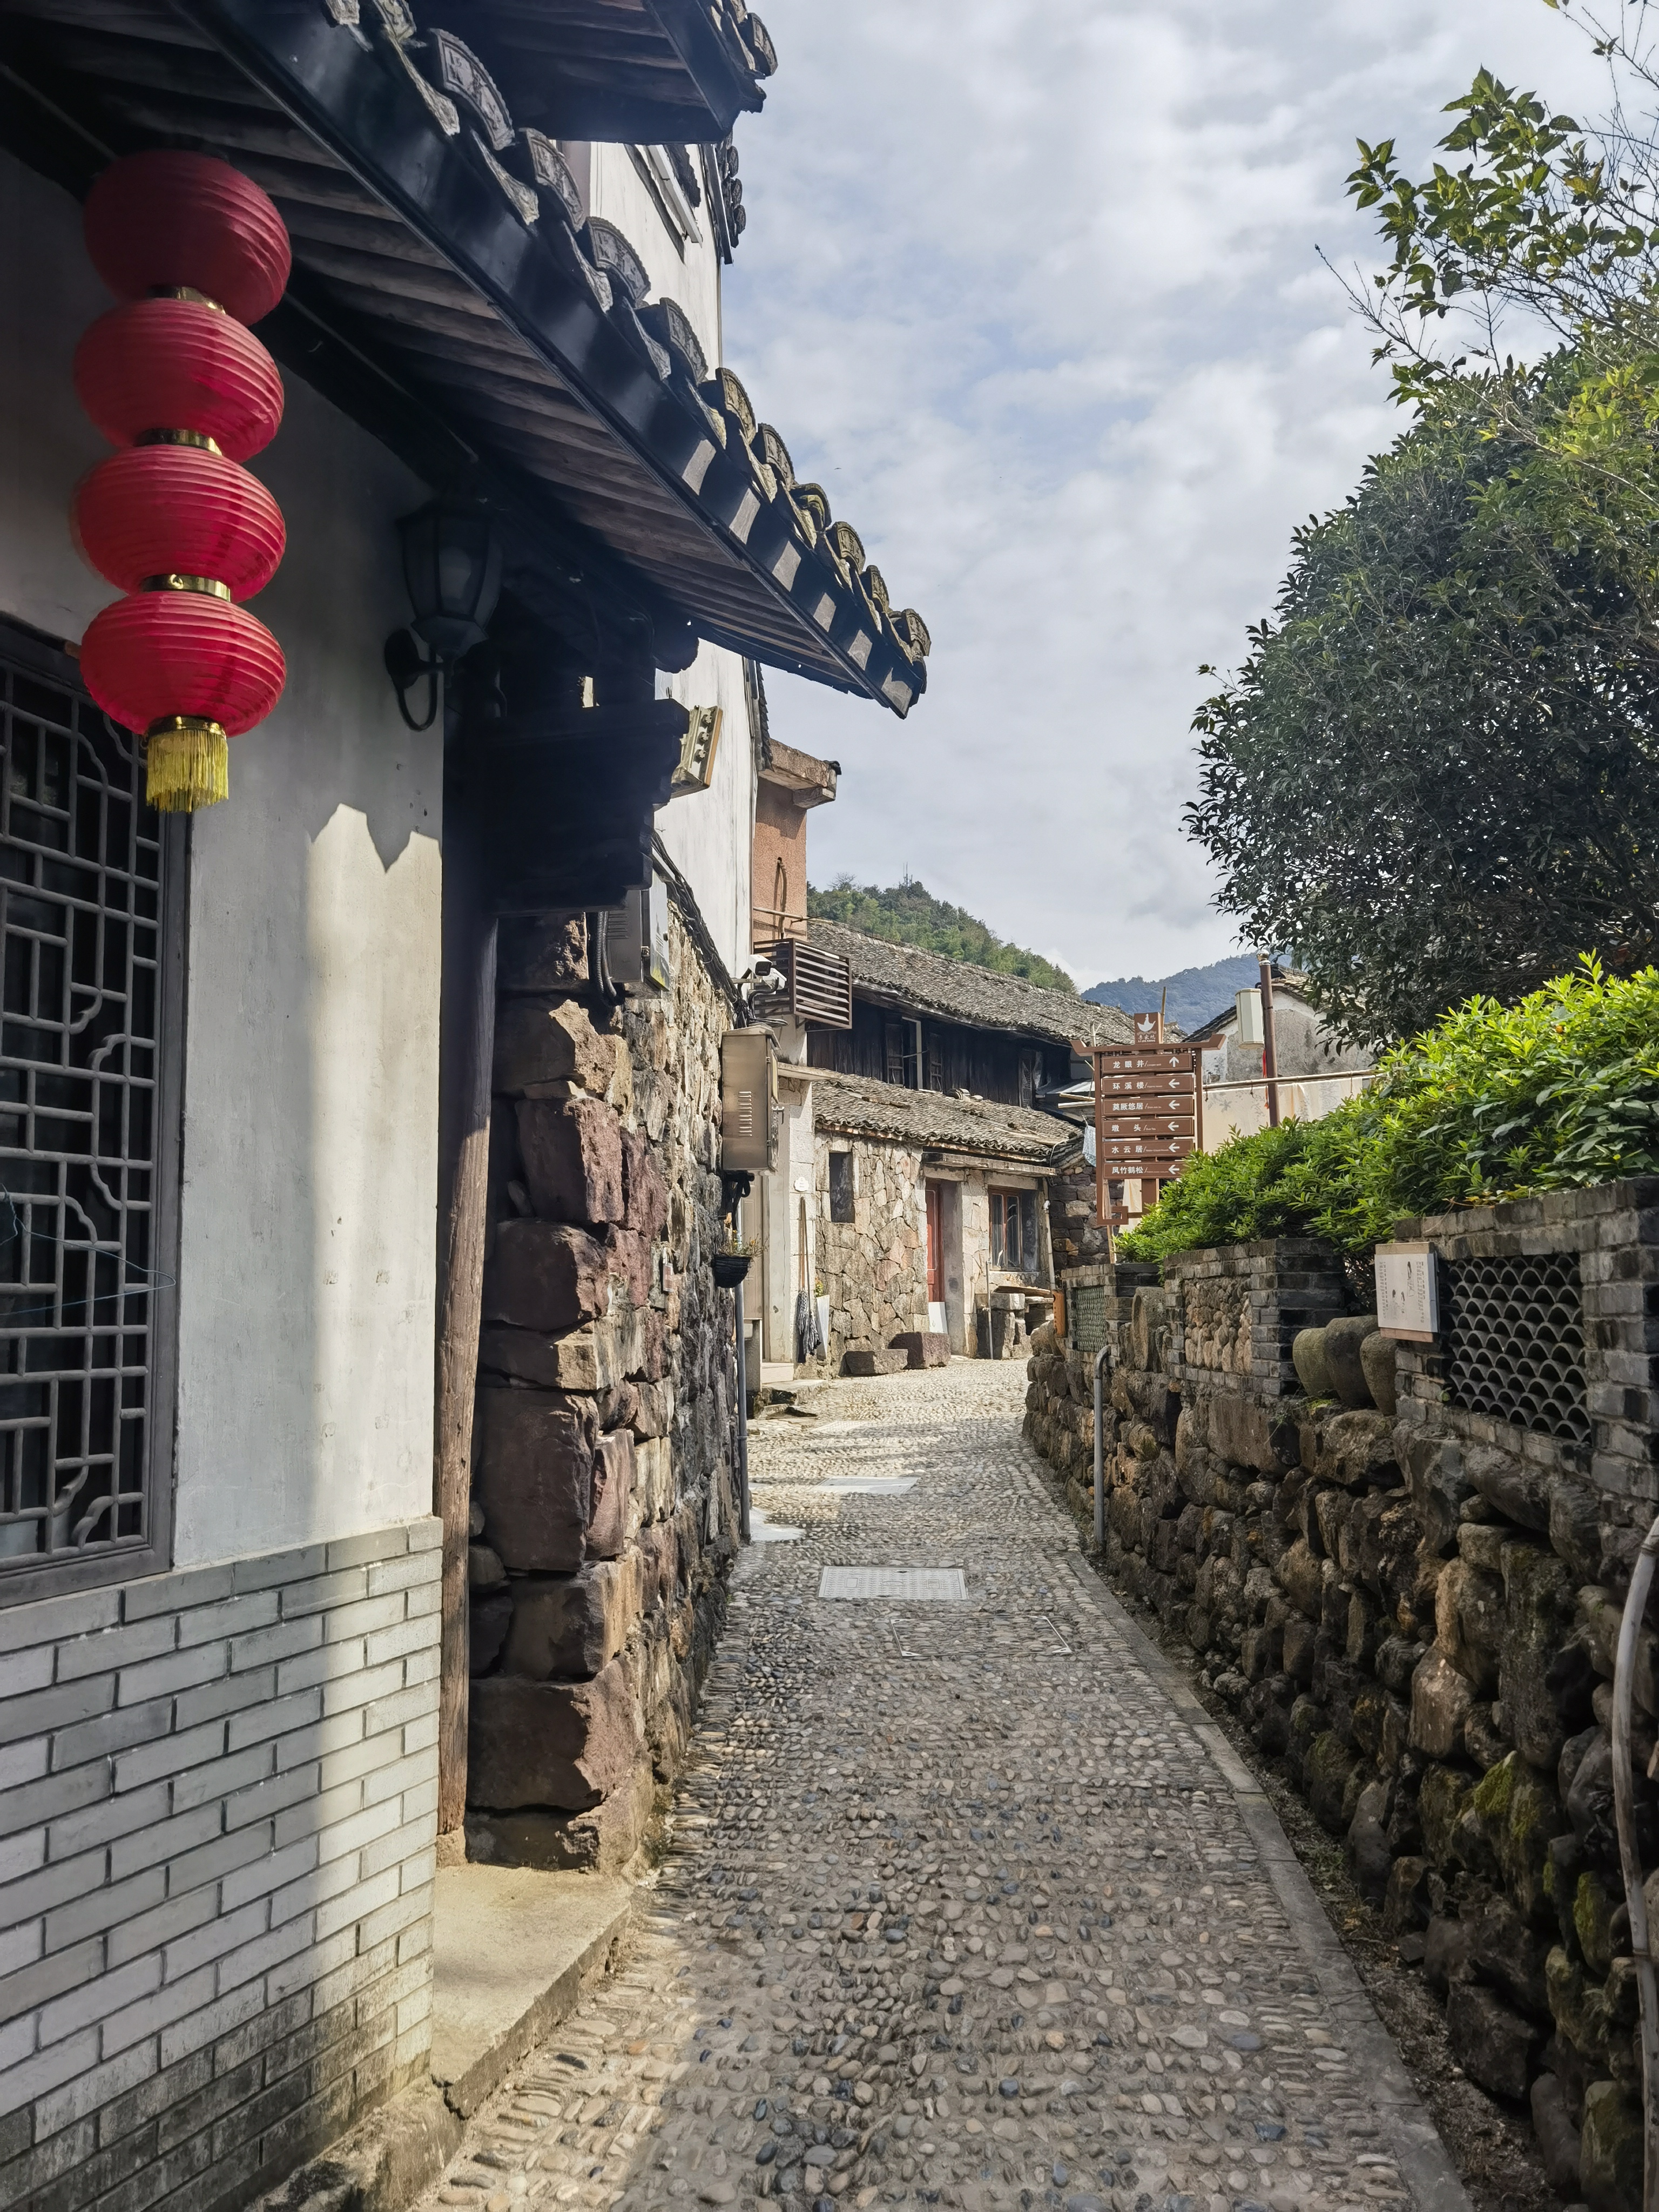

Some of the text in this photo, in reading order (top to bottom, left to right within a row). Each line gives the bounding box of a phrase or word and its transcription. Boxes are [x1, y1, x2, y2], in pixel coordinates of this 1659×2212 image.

[1113, 1060, 1144, 1068] 龙眼井
[1112, 1082, 1144, 1090] 环溪楼
[1111, 1124, 1141, 1132] 墩头
[1111, 1145, 1143, 1154] 水云居
